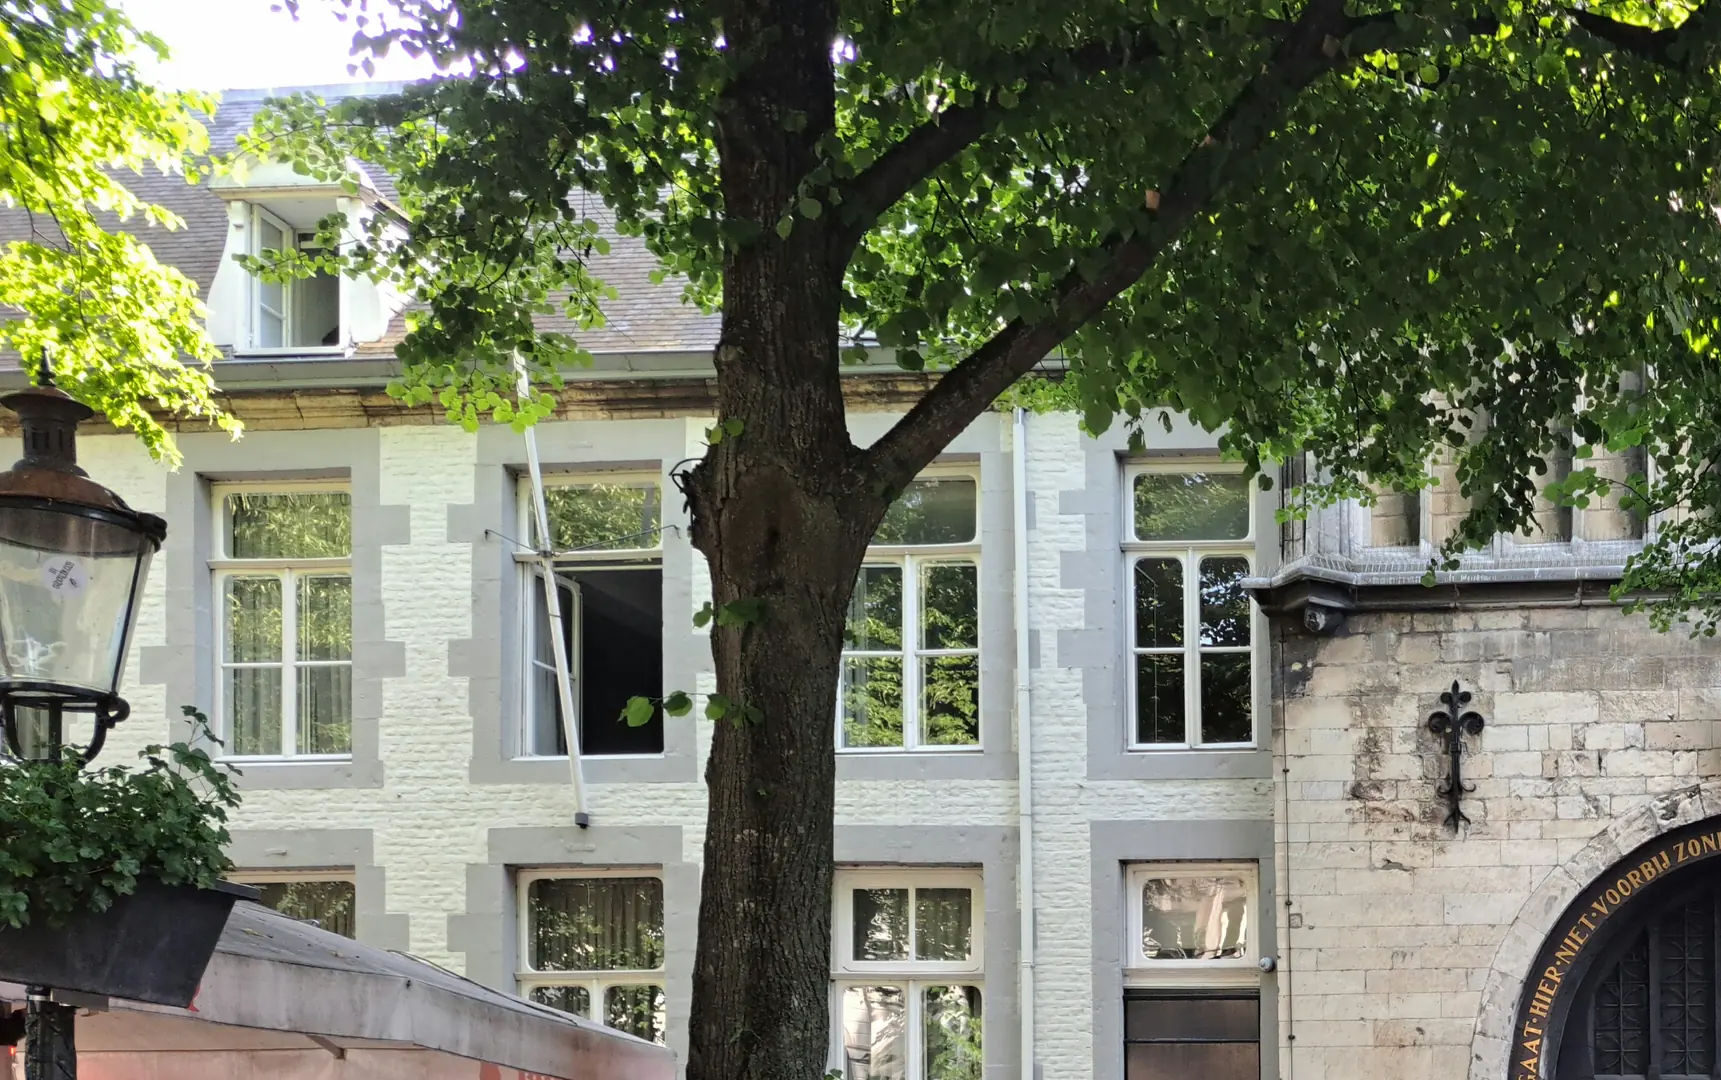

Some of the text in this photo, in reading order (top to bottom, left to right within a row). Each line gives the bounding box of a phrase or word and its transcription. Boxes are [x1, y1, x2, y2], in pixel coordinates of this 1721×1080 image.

[1529, 966, 1565, 1019] HIER
[1556, 913, 1597, 964] NIET
[1592, 851, 1670, 917] VOORBIJ
